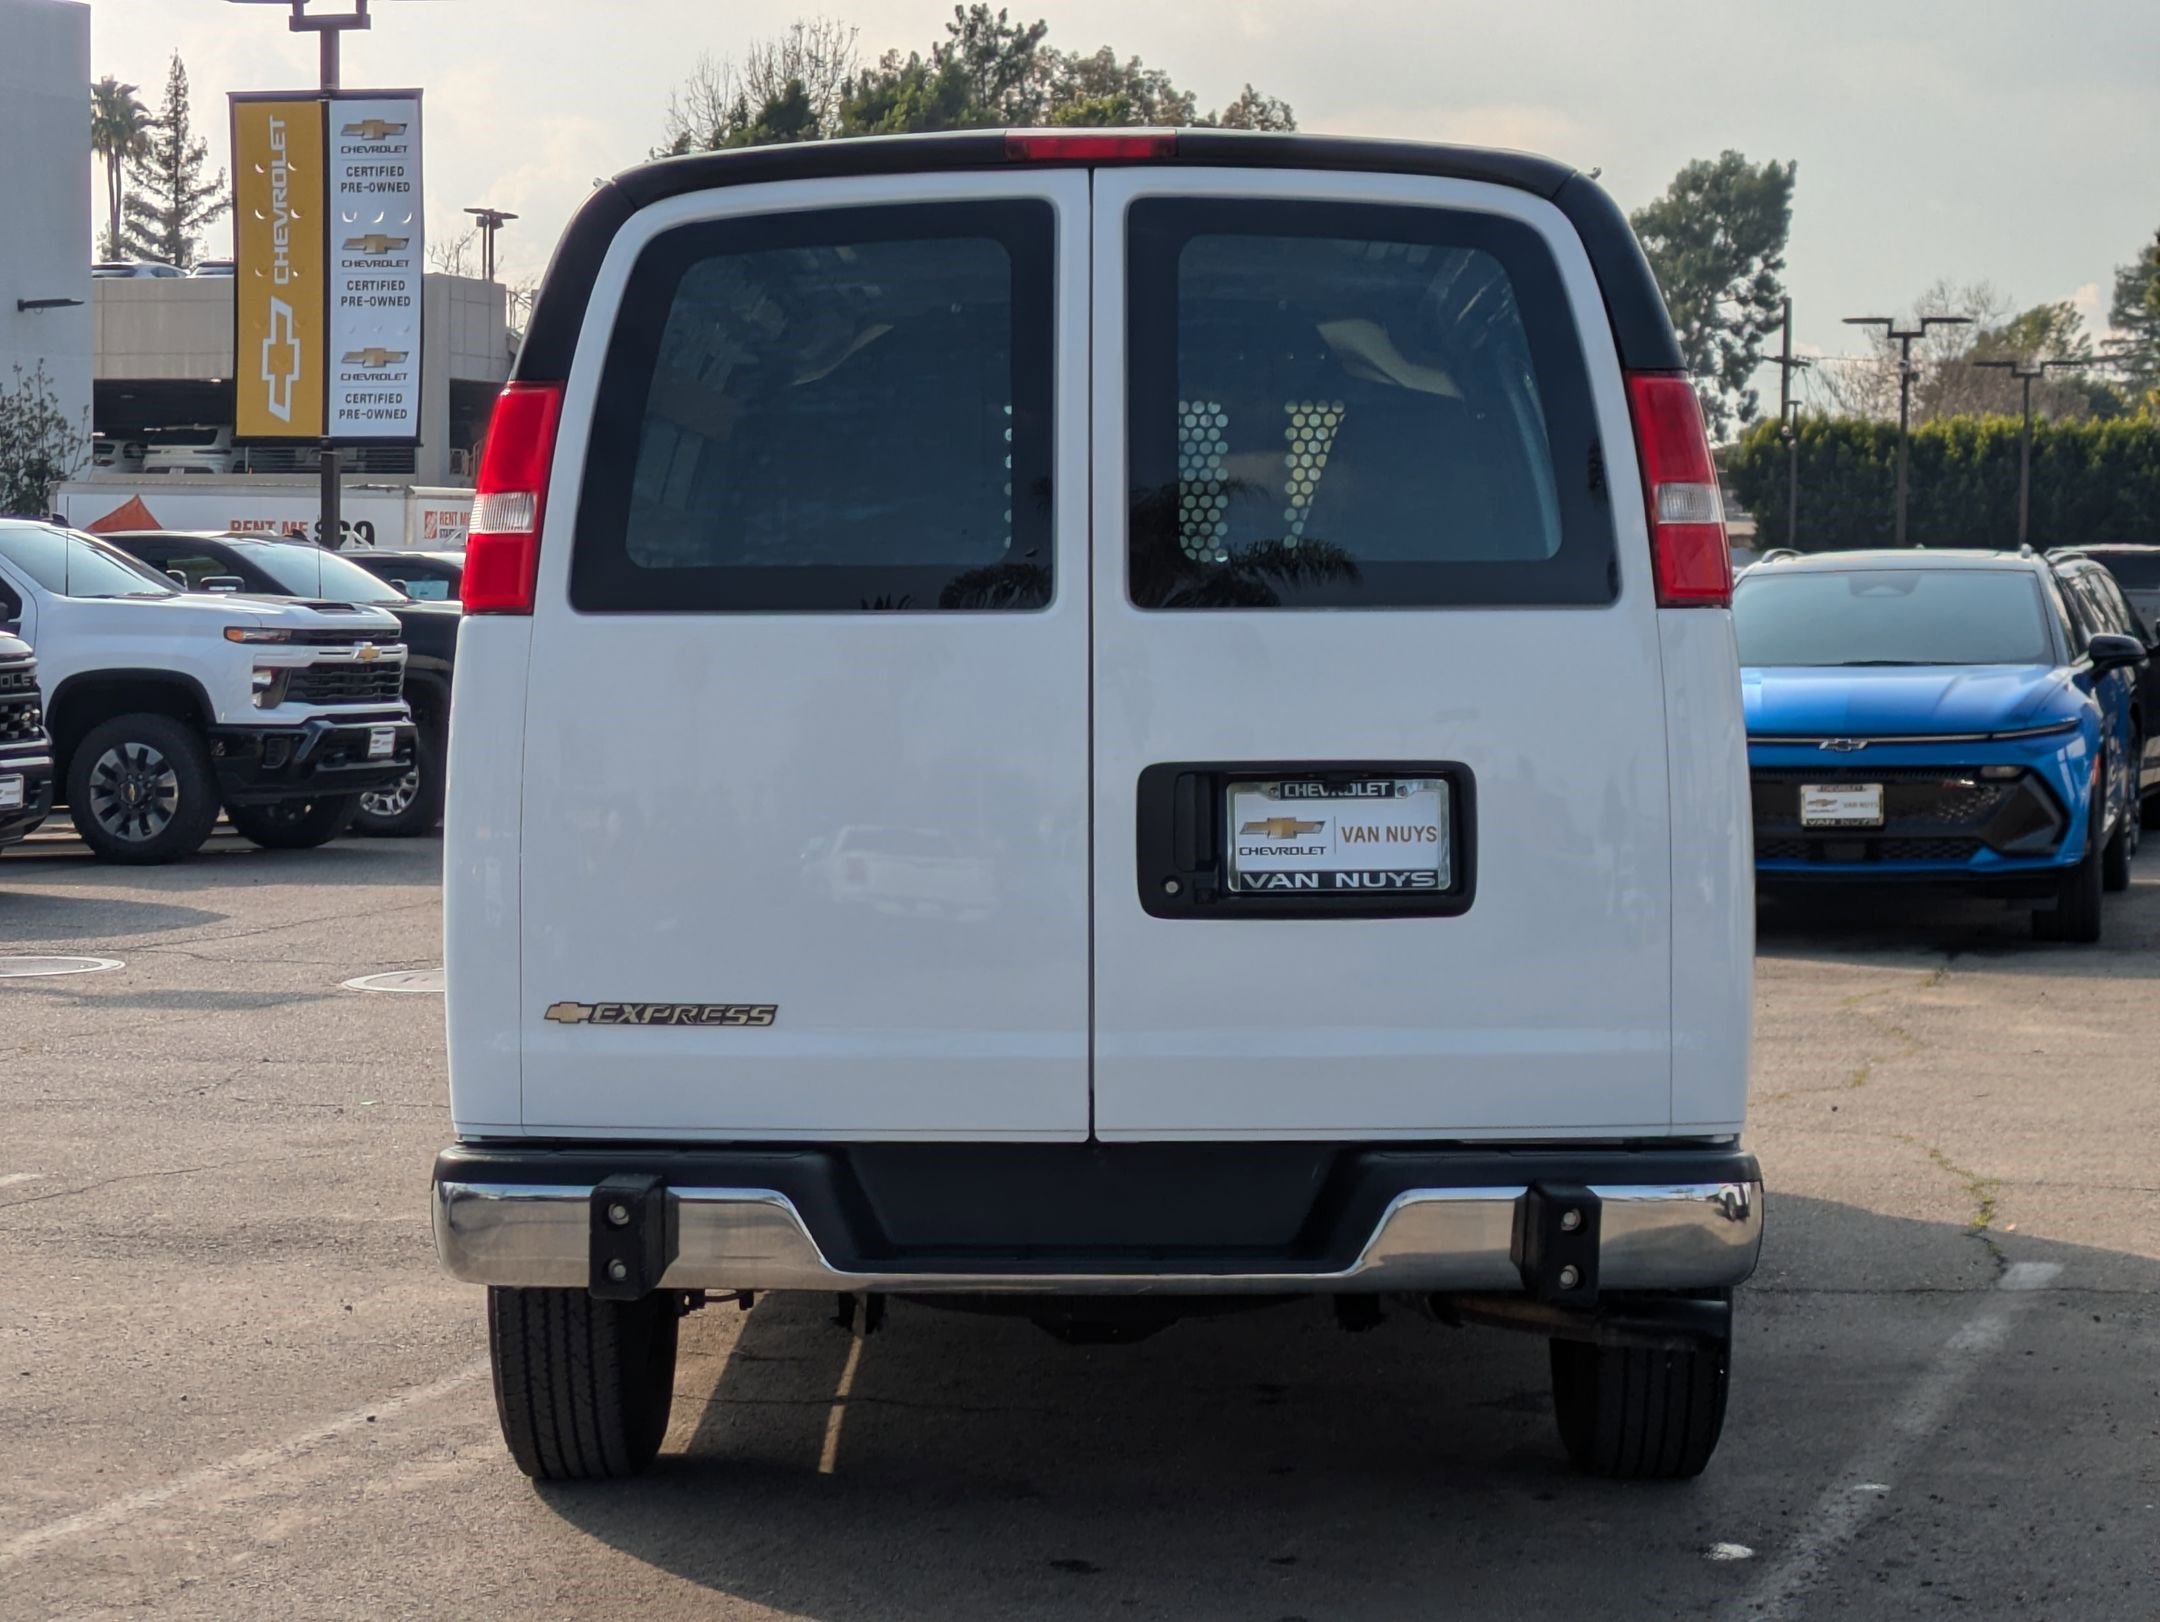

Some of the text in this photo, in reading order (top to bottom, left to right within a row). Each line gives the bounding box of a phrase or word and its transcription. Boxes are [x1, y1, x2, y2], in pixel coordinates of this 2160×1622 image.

[340, 144, 409, 154] CHEVROLET
[346, 165, 405, 177] CERTIFIED
[340, 182, 411, 193] PRE-OWNED
[269, 114, 289, 285] CHEVROLET
[341, 259, 410, 268] CHEVROLET
[346, 279, 406, 291] CERTIFIED
[340, 295, 412, 307] PRE-OWNED
[340, 372, 409, 381] CHEVROLET
[345, 393, 403, 405] CERTIFIED
[339, 408, 408, 420] PRE-OWNED
[1284, 782, 1391, 798] CHEVOLET
[1341, 824, 1438, 844] VAN NUYS
[1239, 845, 1327, 857] CHEVROLET
[1242, 871, 1437, 889] VAN NUYS
[589, 1002, 778, 1026] EXPRESS
